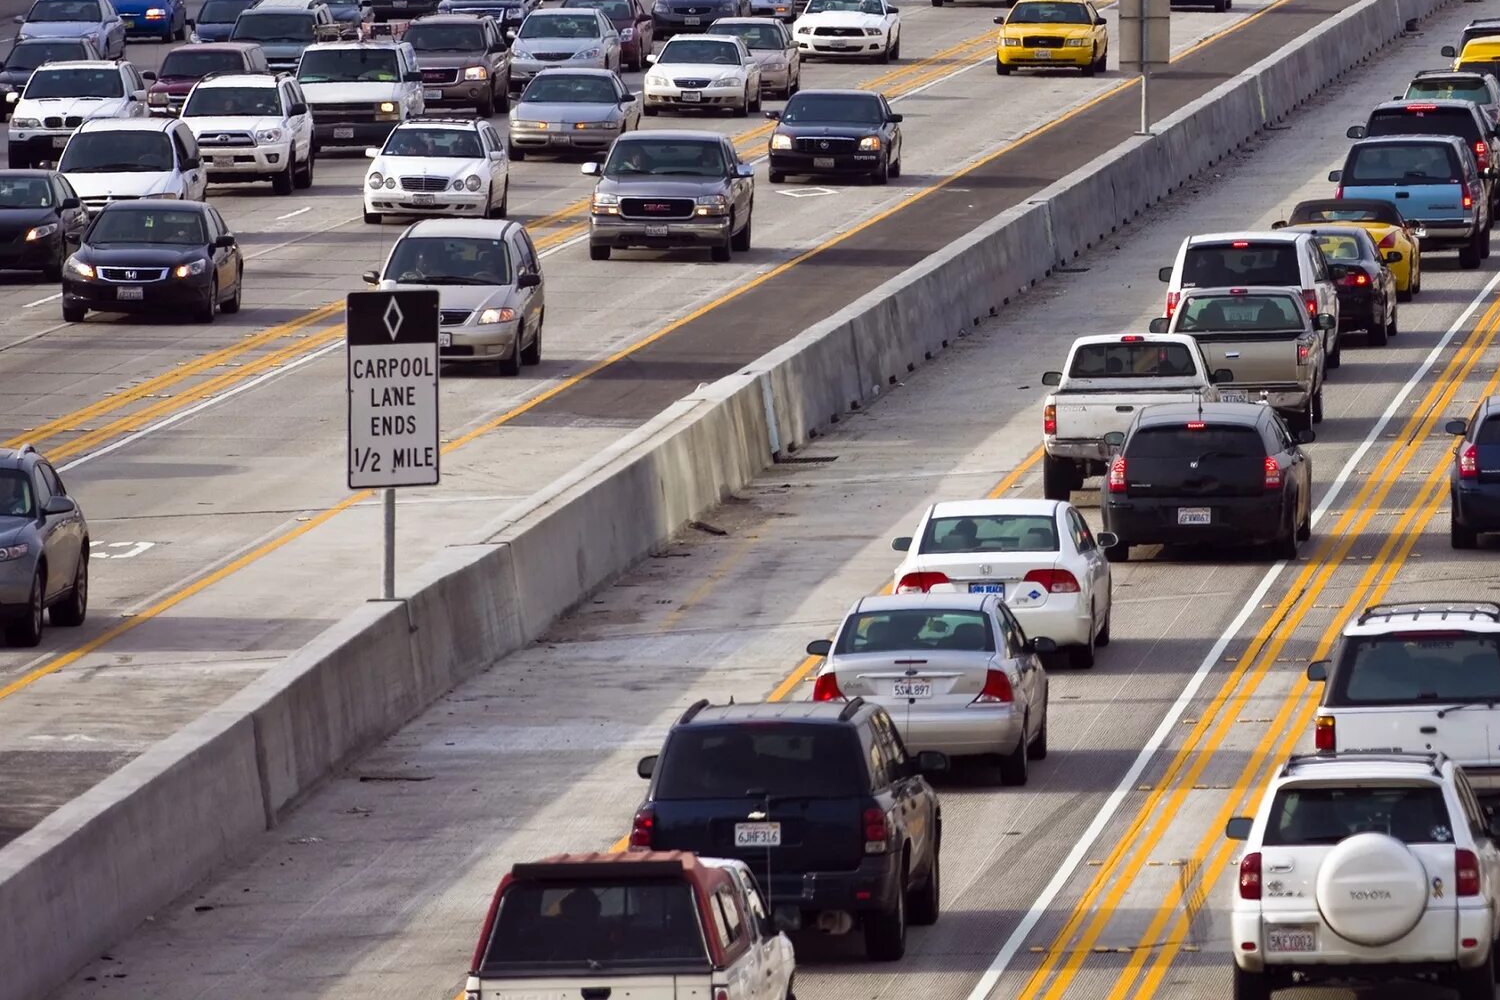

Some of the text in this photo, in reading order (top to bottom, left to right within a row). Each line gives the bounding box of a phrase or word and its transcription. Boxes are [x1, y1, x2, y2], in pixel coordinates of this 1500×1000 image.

[353, 357, 434, 379] CARPOOL
[371, 386, 416, 408] LANE
[371, 415, 416, 436] ENDS
[354, 447, 434, 473] 1/2 MILE
[986, 584, 1004, 594] BEACH
[738, 830, 778, 843] 6JHF316
[1350, 890, 1392, 902] TOYOTA
